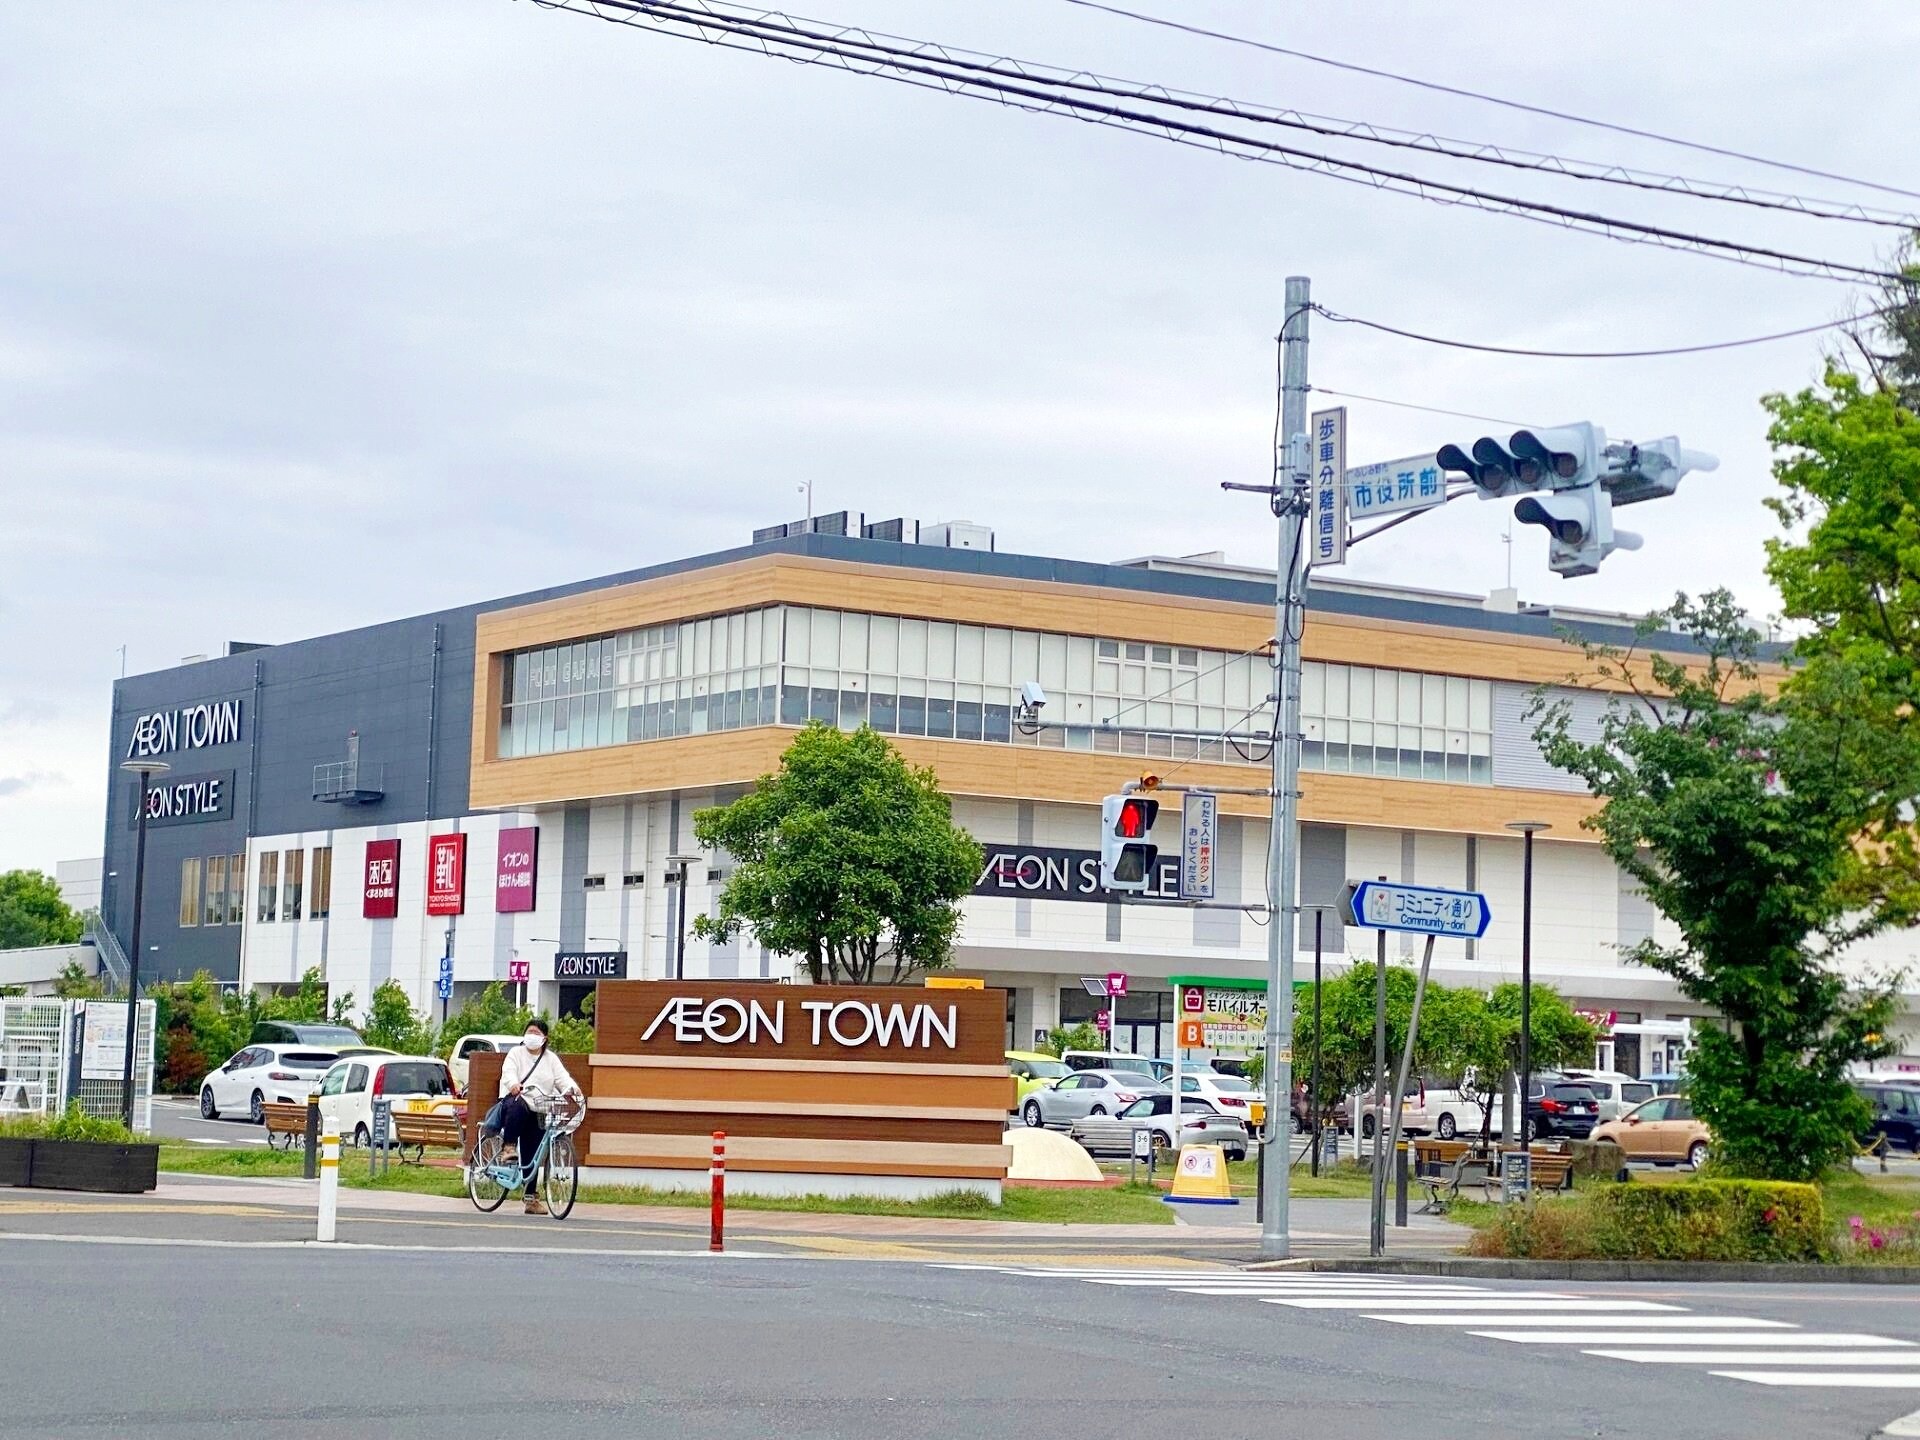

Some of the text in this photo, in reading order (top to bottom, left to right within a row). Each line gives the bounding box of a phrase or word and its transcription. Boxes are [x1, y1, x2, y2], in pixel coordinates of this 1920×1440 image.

[1319, 417, 1335, 558] 歩車分離信号
[1354, 466, 1438, 509] 市役所前
[183, 699, 239, 749] TOWN
[175, 780, 219, 816] STYLE
[502, 851, 530, 868] イオンの
[1187, 828, 1198, 892] おしてください
[1200, 800, 1211, 893] わたる人は押ボタンを
[435, 847, 455, 889] 靴
[1395, 893, 1473, 919] コミュニティ通り
[1400, 913, 1466, 931] Community-dori
[585, 956, 615, 975] STYLE
[801, 1000, 957, 1049] TOWN
[1187, 1025, 1198, 1042] B
